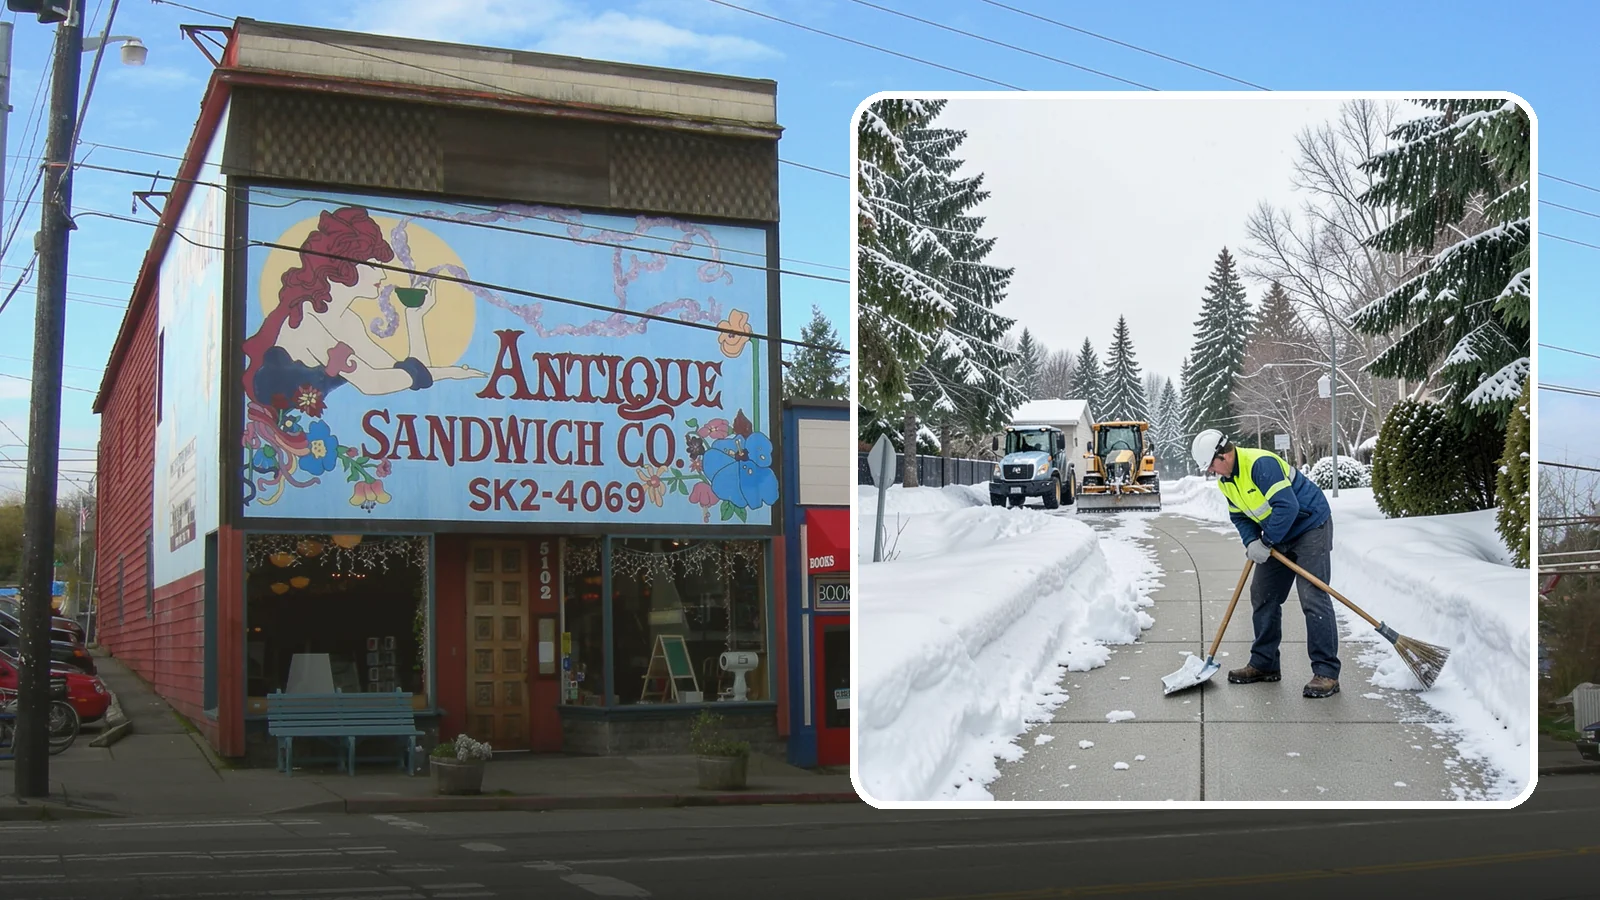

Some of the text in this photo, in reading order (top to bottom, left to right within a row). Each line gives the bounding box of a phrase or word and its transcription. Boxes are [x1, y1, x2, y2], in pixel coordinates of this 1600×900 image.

[475, 329, 724, 421] ANTIQUE
[360, 408, 685, 469] SANDWICH CO.
[468, 477, 645, 512] SK2-4069
[540, 541, 551, 600] 5102
[809, 555, 835, 569] BOOKS
